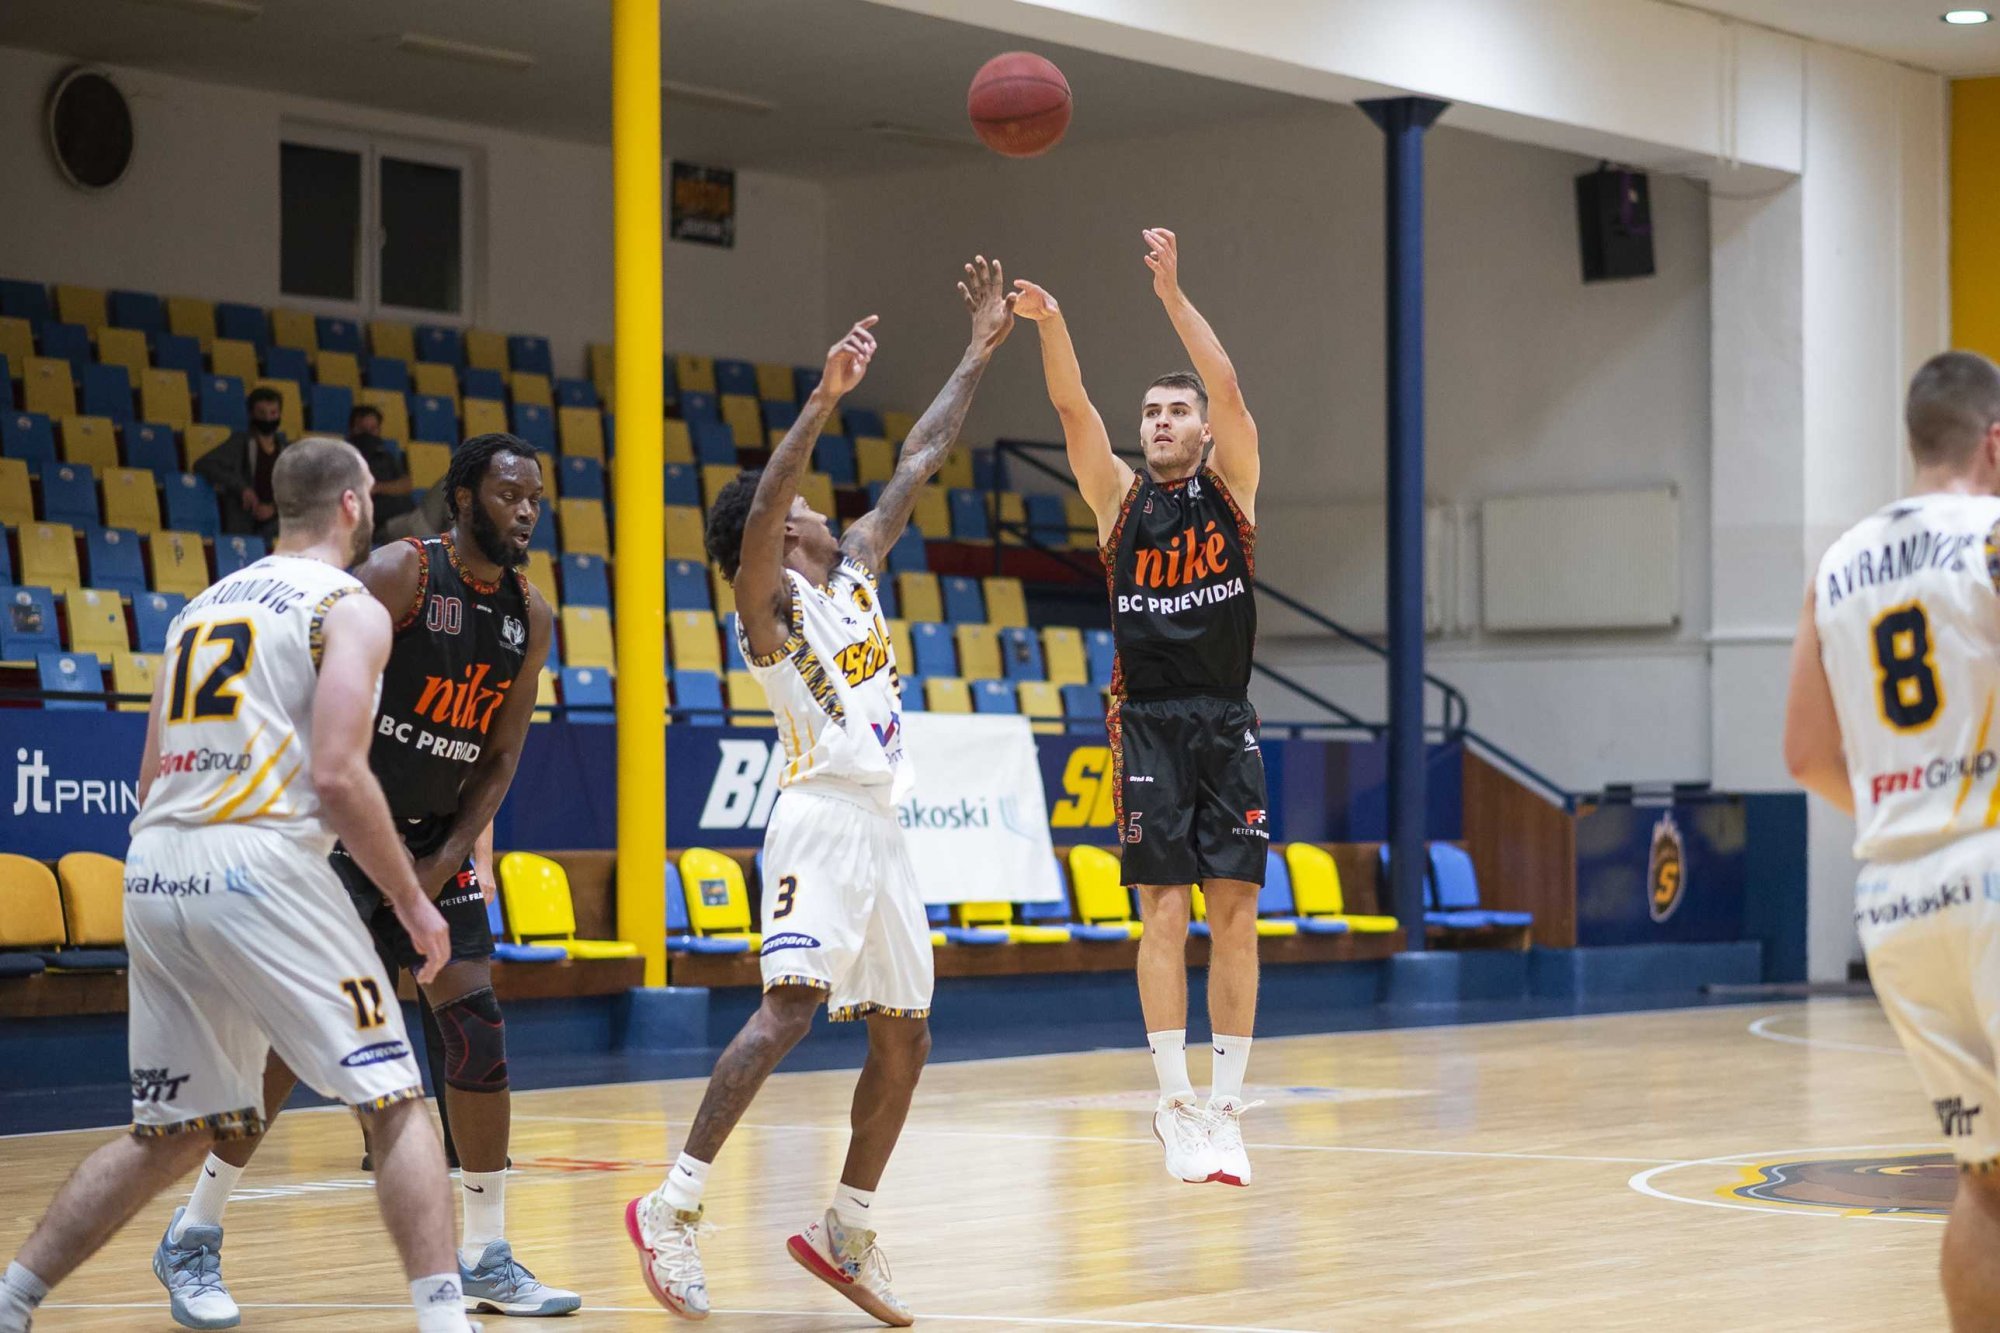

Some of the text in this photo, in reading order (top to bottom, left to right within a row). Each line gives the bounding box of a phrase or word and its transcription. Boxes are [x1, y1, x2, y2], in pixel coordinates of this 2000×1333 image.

[1135, 520, 1228, 588] niké
[1118, 577, 1245, 615] BC PRIEVIDZA
[168, 618, 257, 727] 12
[1868, 598, 1947, 735] 8
[378, 714, 413, 744] BC
[897, 798, 989, 829] akoski
[1127, 811, 1143, 844] 5
[124, 872, 211, 897] vakoski
[440, 896, 468, 907] PETER
[773, 874, 797, 920] 3
